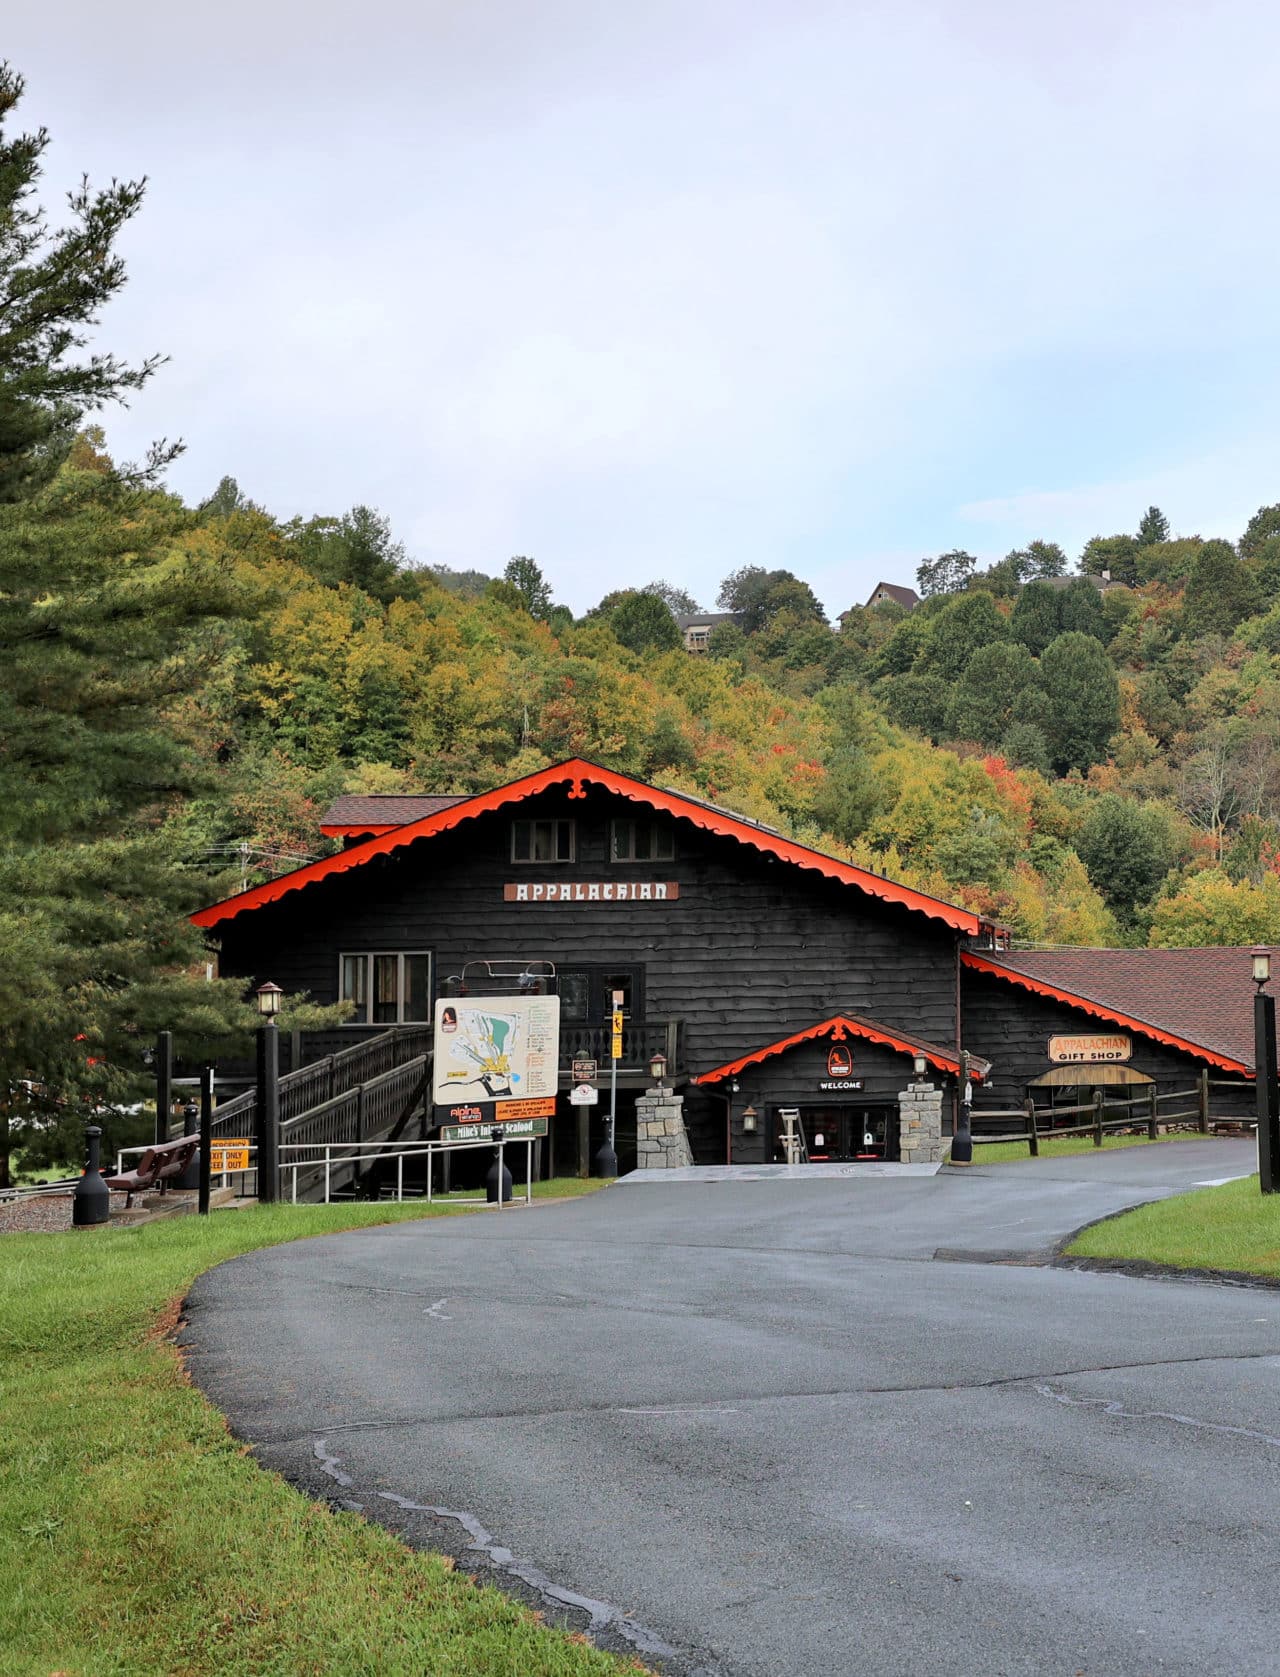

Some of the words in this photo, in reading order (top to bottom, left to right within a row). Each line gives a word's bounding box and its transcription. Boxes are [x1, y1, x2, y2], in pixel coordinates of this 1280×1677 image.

[516, 883, 667, 900] APPALACHIAN
[1055, 1037, 1127, 1052] APPALACHIAN
[820, 1081, 861, 1089] WELCOME
[506, 1120, 533, 1134] Seafood
[226, 1151, 243, 1159] ONLY
